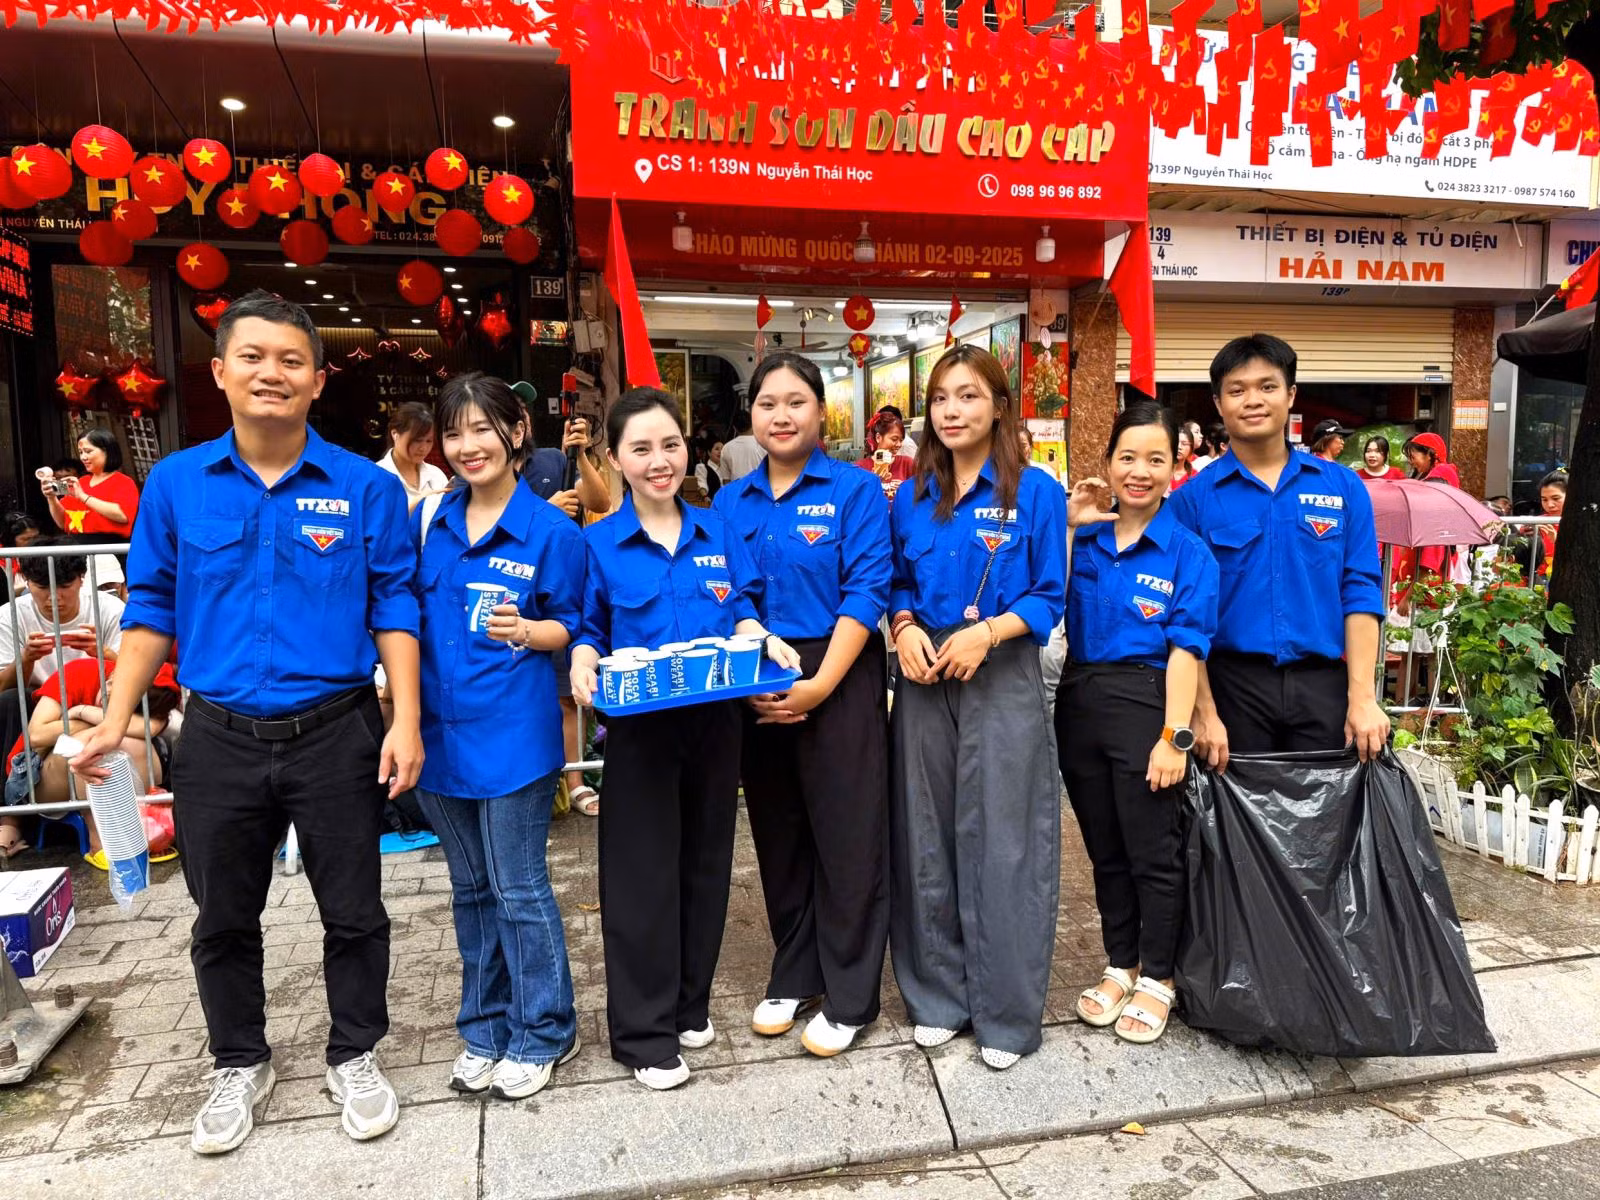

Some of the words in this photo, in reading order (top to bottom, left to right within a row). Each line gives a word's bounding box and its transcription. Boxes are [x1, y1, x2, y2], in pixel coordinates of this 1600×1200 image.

[614, 92, 758, 143] TRANH
[957, 116, 1032, 158] CAO
[1464, 137, 1470, 148] 3
[361, 163, 377, 180] &
[657, 154, 682, 171] CS
[709, 158, 750, 175] 139N
[757, 162, 809, 181] Nguyễn
[815, 165, 842, 180] Thái
[847, 167, 873, 184] Học
[1444, 156, 1477, 169] HDPE
[1154, 164, 1181, 174] 139P
[1184, 166, 1225, 179] Nguyễn
[1228, 168, 1250, 179] Thái
[1253, 170, 1273, 182] Học
[86, 172, 217, 215] HY
[1011, 184, 1034, 198] 098
[1039, 186, 1054, 199] 96
[1058, 186, 1074, 199] 96
[1078, 186, 1101, 199] 892
[1438, 182, 1455, 191] 024
[1459, 183, 1481, 193] 3823
[1484, 185, 1506, 194] 3217
[1514, 187, 1537, 196] 0987
[1540, 188, 1556, 197] 574
[1559, 189, 1575, 199] 160
[1149, 226, 1171, 242] 139
[1236, 221, 1298, 242] THIẾT
[1305, 228, 1325, 246] BỊ
[1334, 227, 1385, 249] ĐIỆN
[1392, 231, 1408, 246] &
[1417, 227, 1443, 247] TỦ
[1450, 228, 1498, 252] ĐIỆN
[741, 231, 797, 258] MỪNG
[805, 234, 853, 262] QUỐC
[875, 237, 920, 264] HÁNH
[925, 244, 1023, 267] 02-09-2025
[1158, 245, 1165, 260] 4
[1279, 251, 1343, 280] HẢI
[1357, 259, 1445, 282] NAM
[535, 280, 561, 295] 139
[624, 672, 632, 702] SWEA
[648, 660, 659, 697] POCARI
